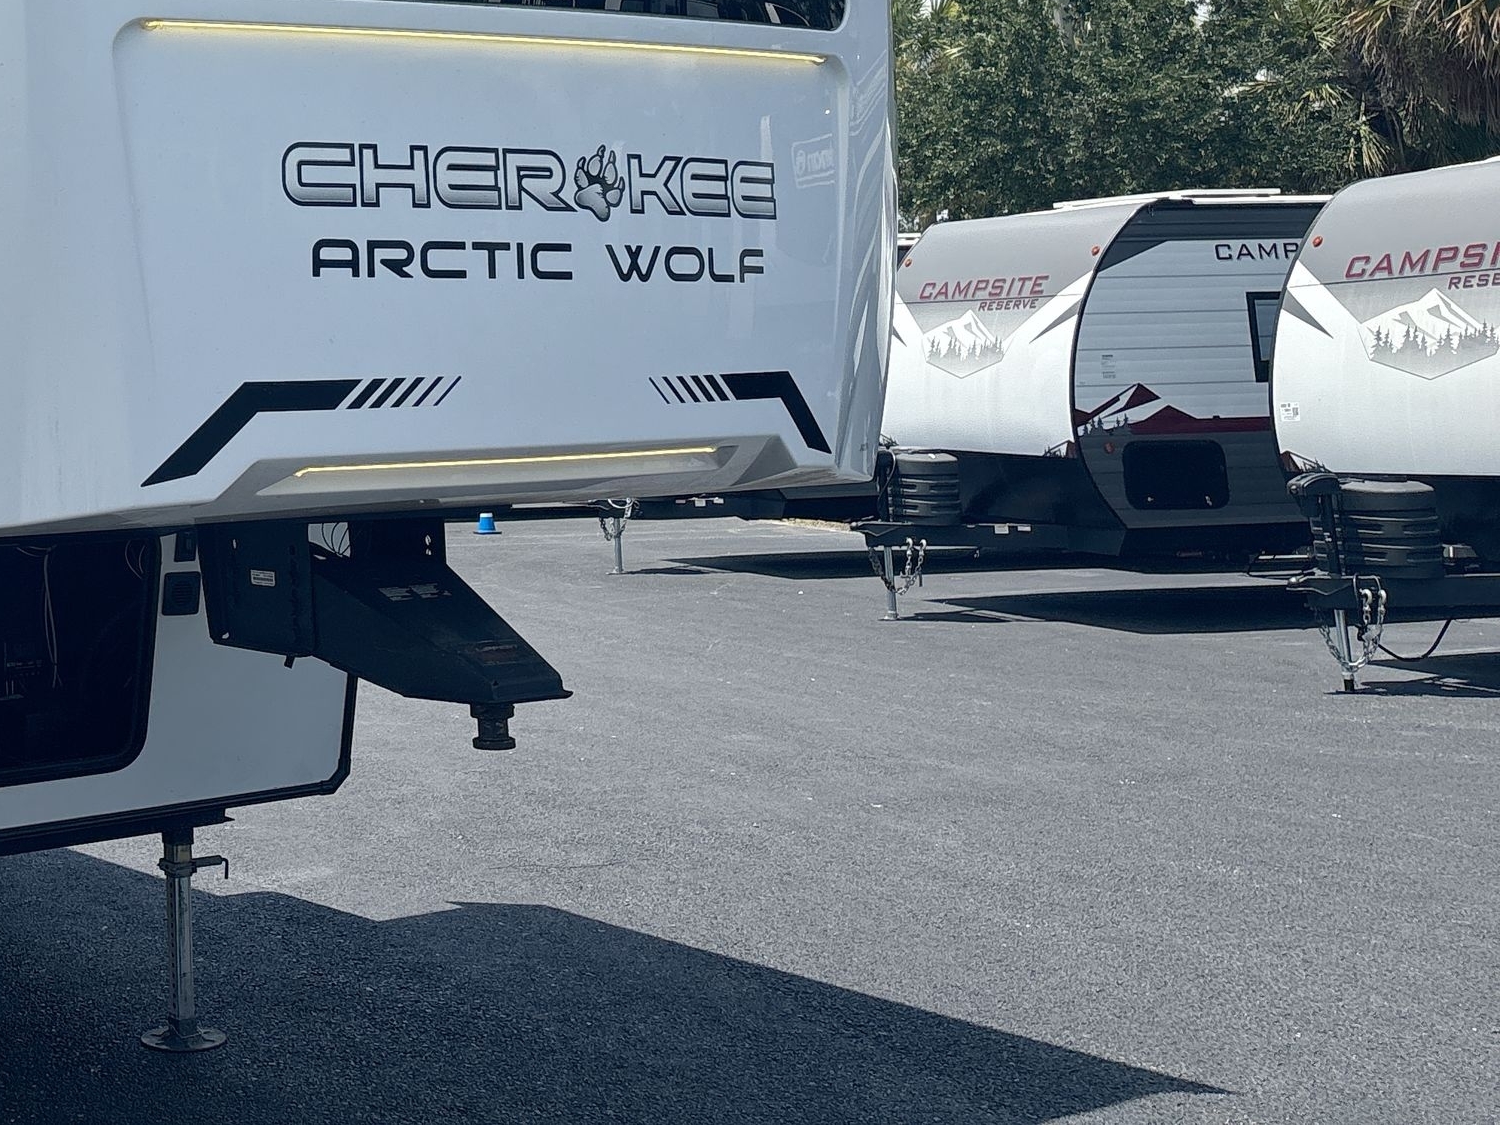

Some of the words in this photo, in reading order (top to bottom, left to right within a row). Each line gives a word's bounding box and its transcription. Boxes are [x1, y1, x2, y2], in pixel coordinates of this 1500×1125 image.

[311, 238, 573, 280] ARCTIC
[605, 244, 764, 283] WOLF
[1214, 242, 1299, 261] CAMP
[919, 275, 1050, 300] CAMPSITE
[978, 299, 1039, 312] RESERVE
